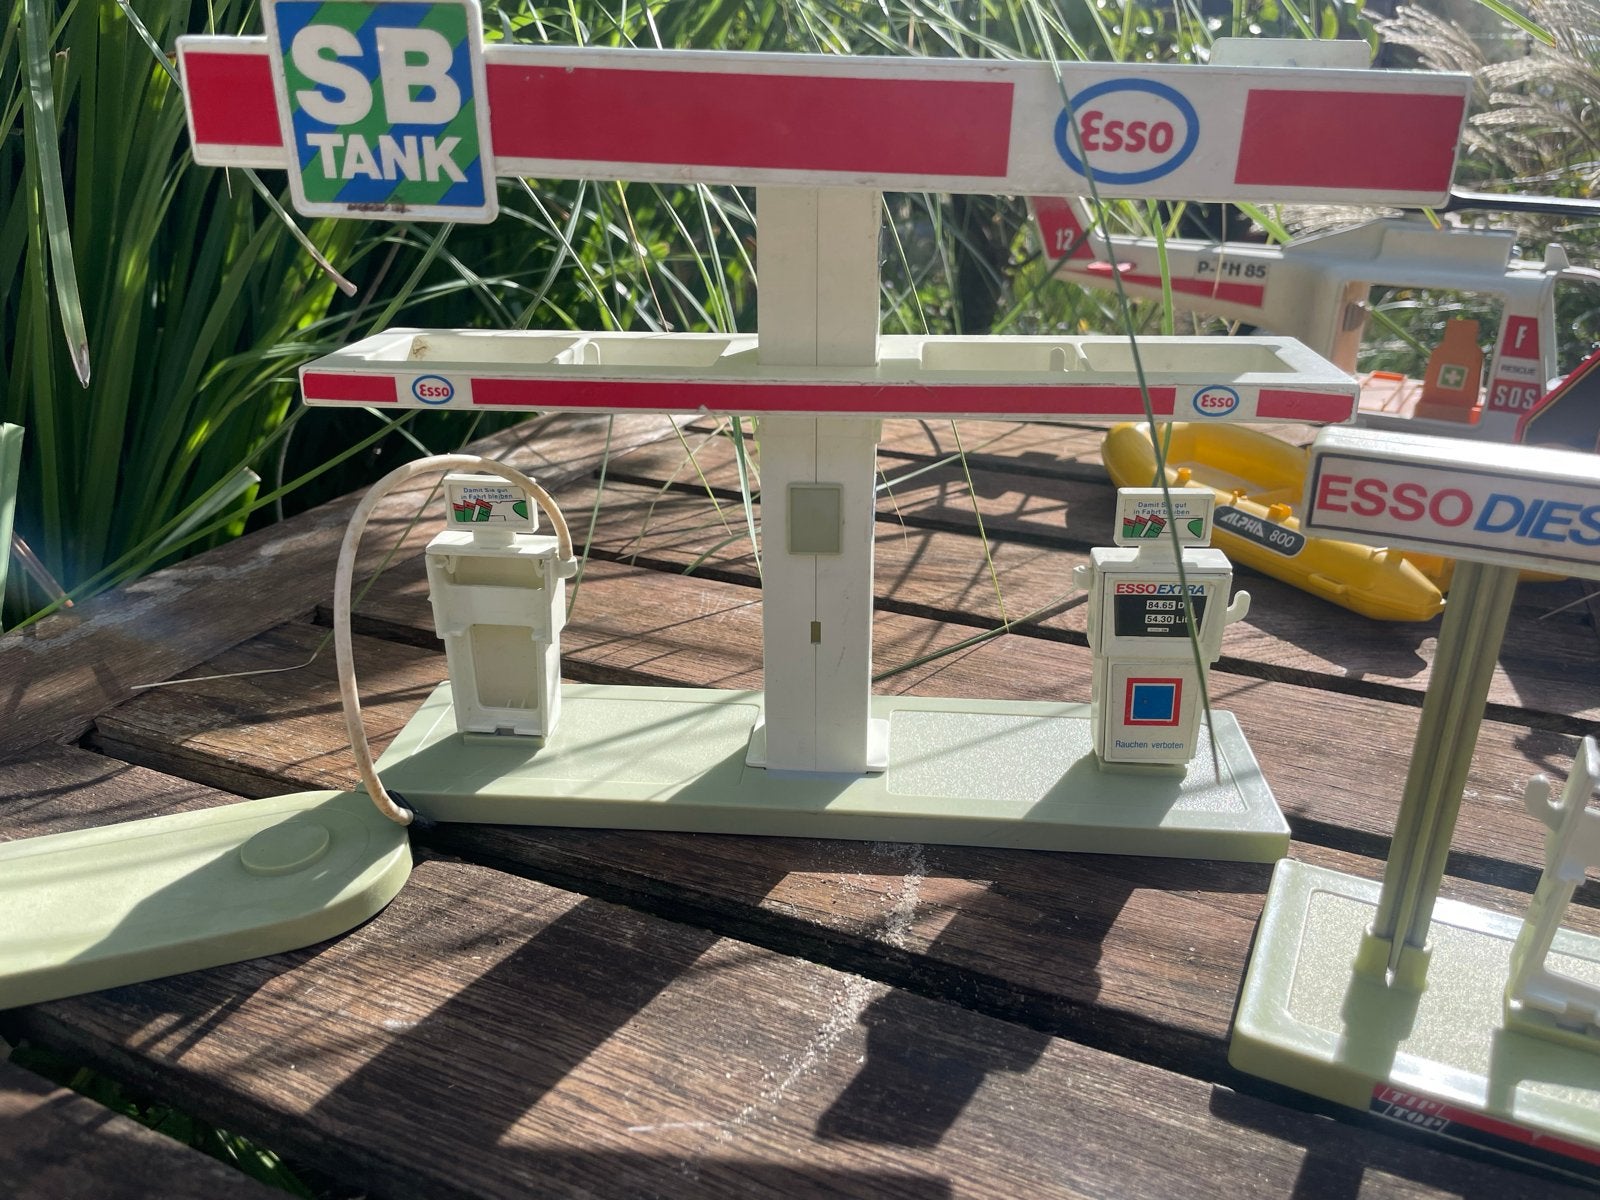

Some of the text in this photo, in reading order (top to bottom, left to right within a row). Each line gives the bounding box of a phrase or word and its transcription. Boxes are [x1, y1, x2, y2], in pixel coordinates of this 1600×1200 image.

[292, 24, 462, 126] SB
[1079, 110, 1175, 154] Esso
[306, 132, 469, 184] TANK
[1055, 228, 1074, 251] 12
[1244, 263, 1267, 278] 85
[1515, 325, 1529, 350] F
[418, 384, 450, 397] Esso
[1201, 394, 1235, 408] Esso
[1494, 385, 1537, 410] SOS
[1220, 512, 1296, 549] ALPHA 800
[1147, 601, 1175, 609] 84.65
[1146, 615, 1173, 623] 54.30
[1115, 739, 1184, 750] Rauchen verboten
[1391, 1090, 1437, 1110] TIP
[1393, 1106, 1443, 1127] TOP
